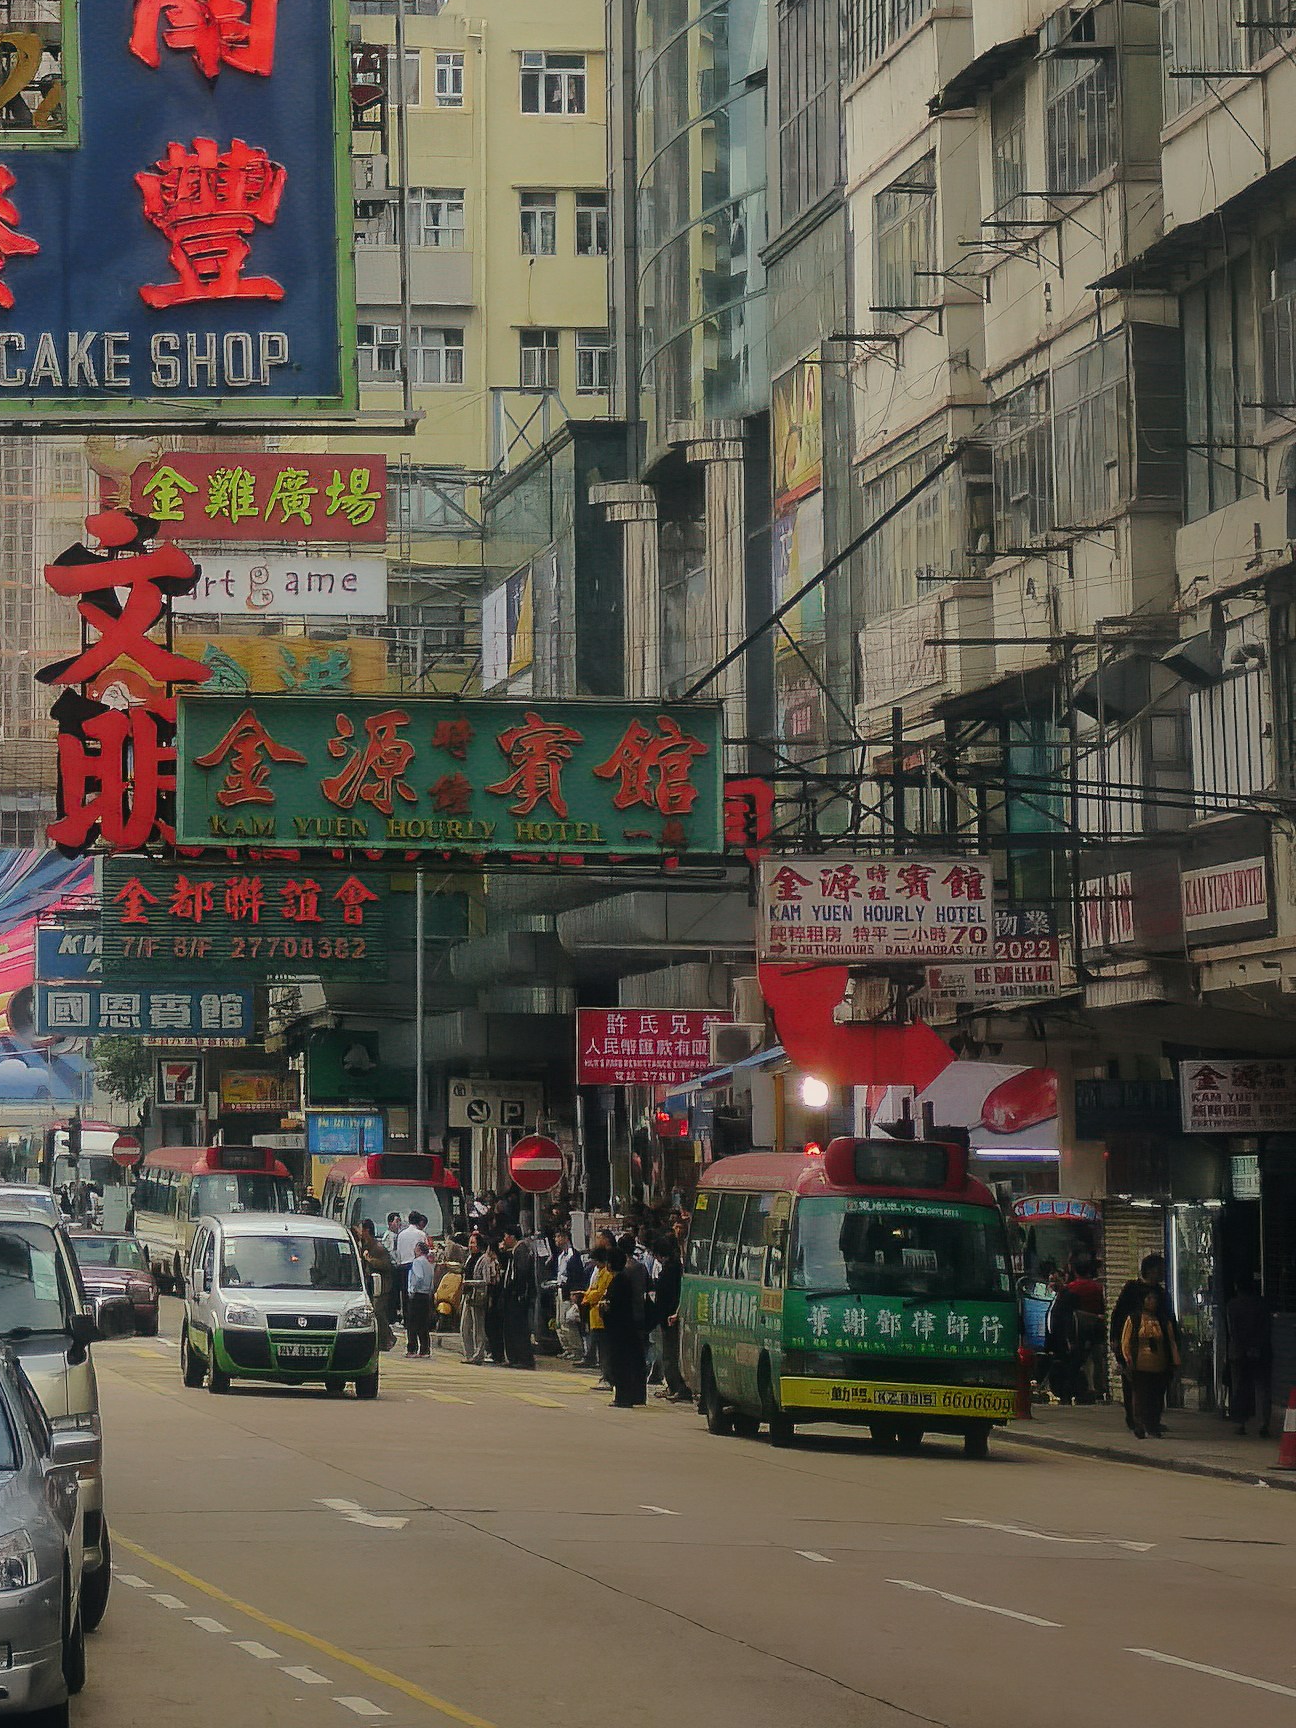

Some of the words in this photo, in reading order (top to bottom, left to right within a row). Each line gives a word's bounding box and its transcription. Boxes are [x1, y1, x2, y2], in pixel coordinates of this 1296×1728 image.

[151, 330, 292, 389] SHOP
[210, 815, 277, 839] KAM
[386, 818, 497, 842] HOURLY
[515, 821, 607, 844] HOTEL
[769, 906, 801, 922] KAM
[812, 906, 853, 922] YUEN
[863, 905, 926, 922] HOURLY
[936, 905, 987, 922] HOTEL
